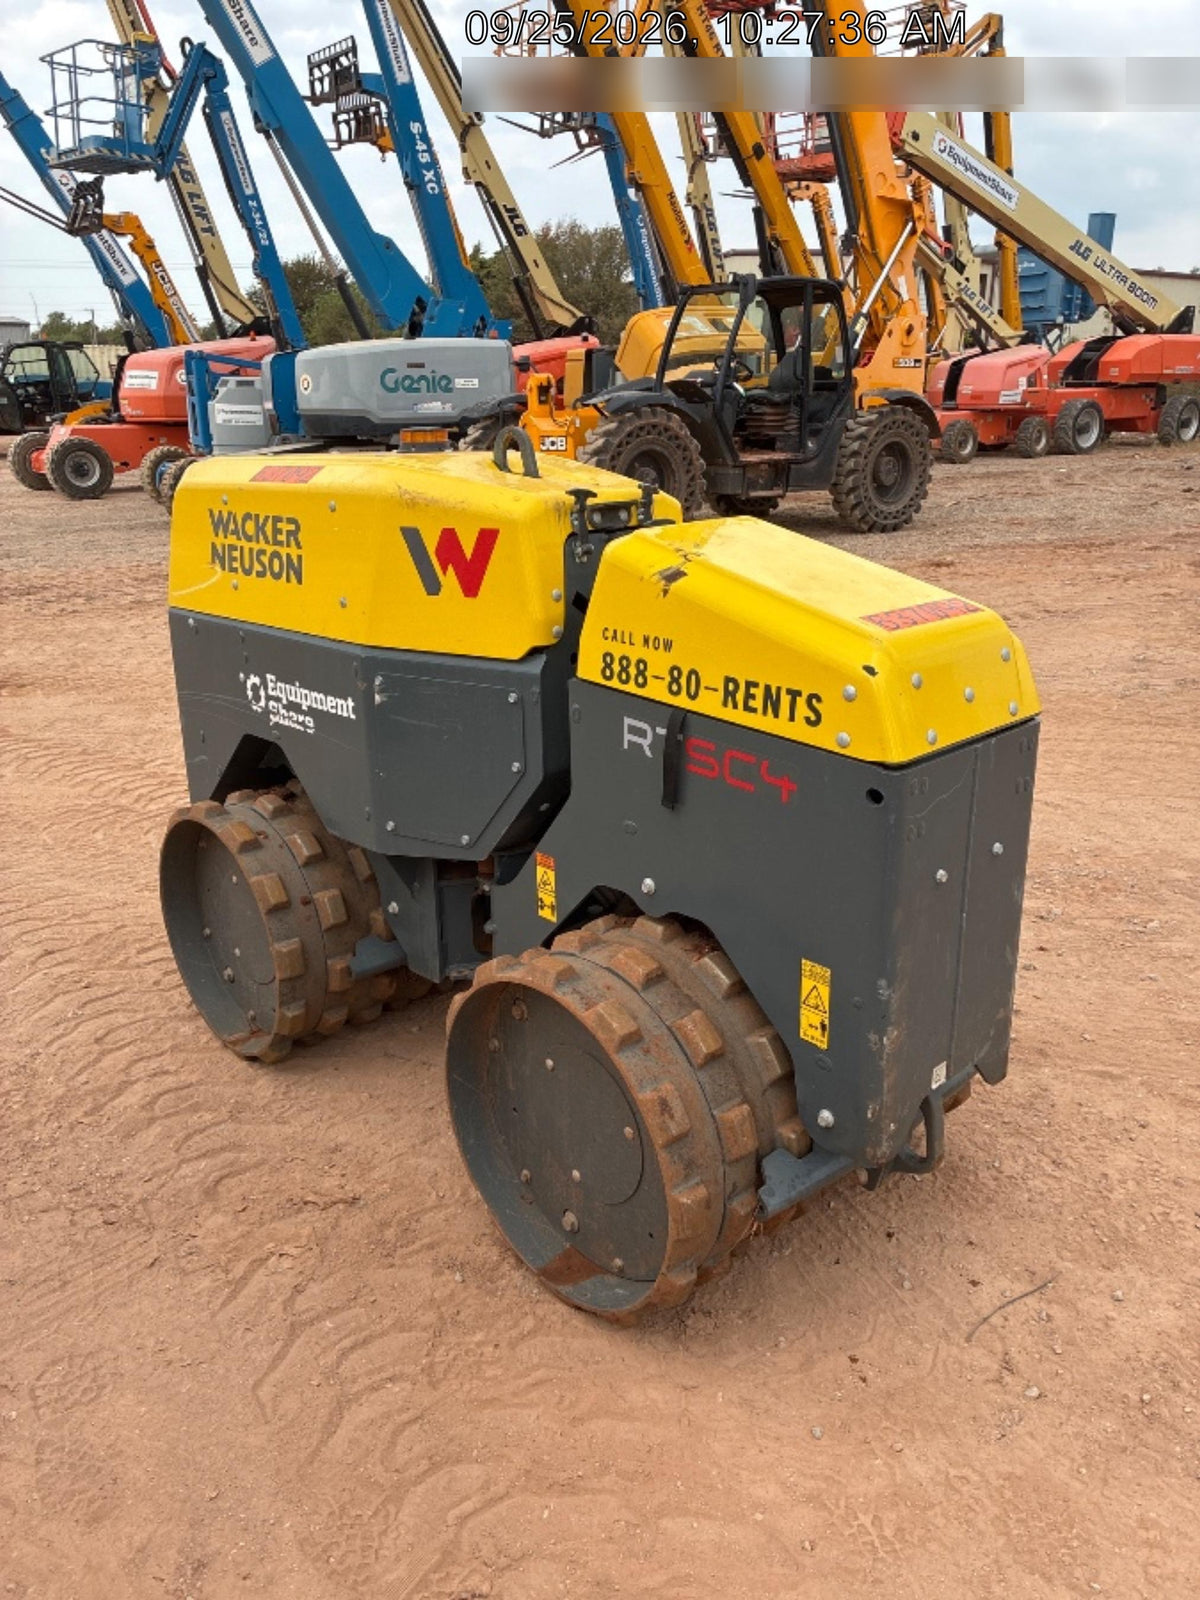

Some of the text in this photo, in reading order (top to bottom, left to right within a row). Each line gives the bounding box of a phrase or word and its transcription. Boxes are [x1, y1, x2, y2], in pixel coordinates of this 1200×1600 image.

[409, 121, 440, 196] S-45 XC
[947, 144, 1013, 203] EquipmentShare
[186, 191, 216, 237] LIFT
[503, 204, 529, 236] JLG
[152, 260, 176, 296] JCB
[1068, 239, 1159, 310] JLG ULTRA BOOM
[380, 368, 454, 394] Genie
[540, 436, 567, 451] JCB
[208, 508, 303, 550] WACKER
[210, 542, 303, 585] NEUSON
[602, 627, 674, 653] CALL NOW
[265, 673, 357, 720] Equipment
[600, 652, 824, 728] 888-80-RENTS
